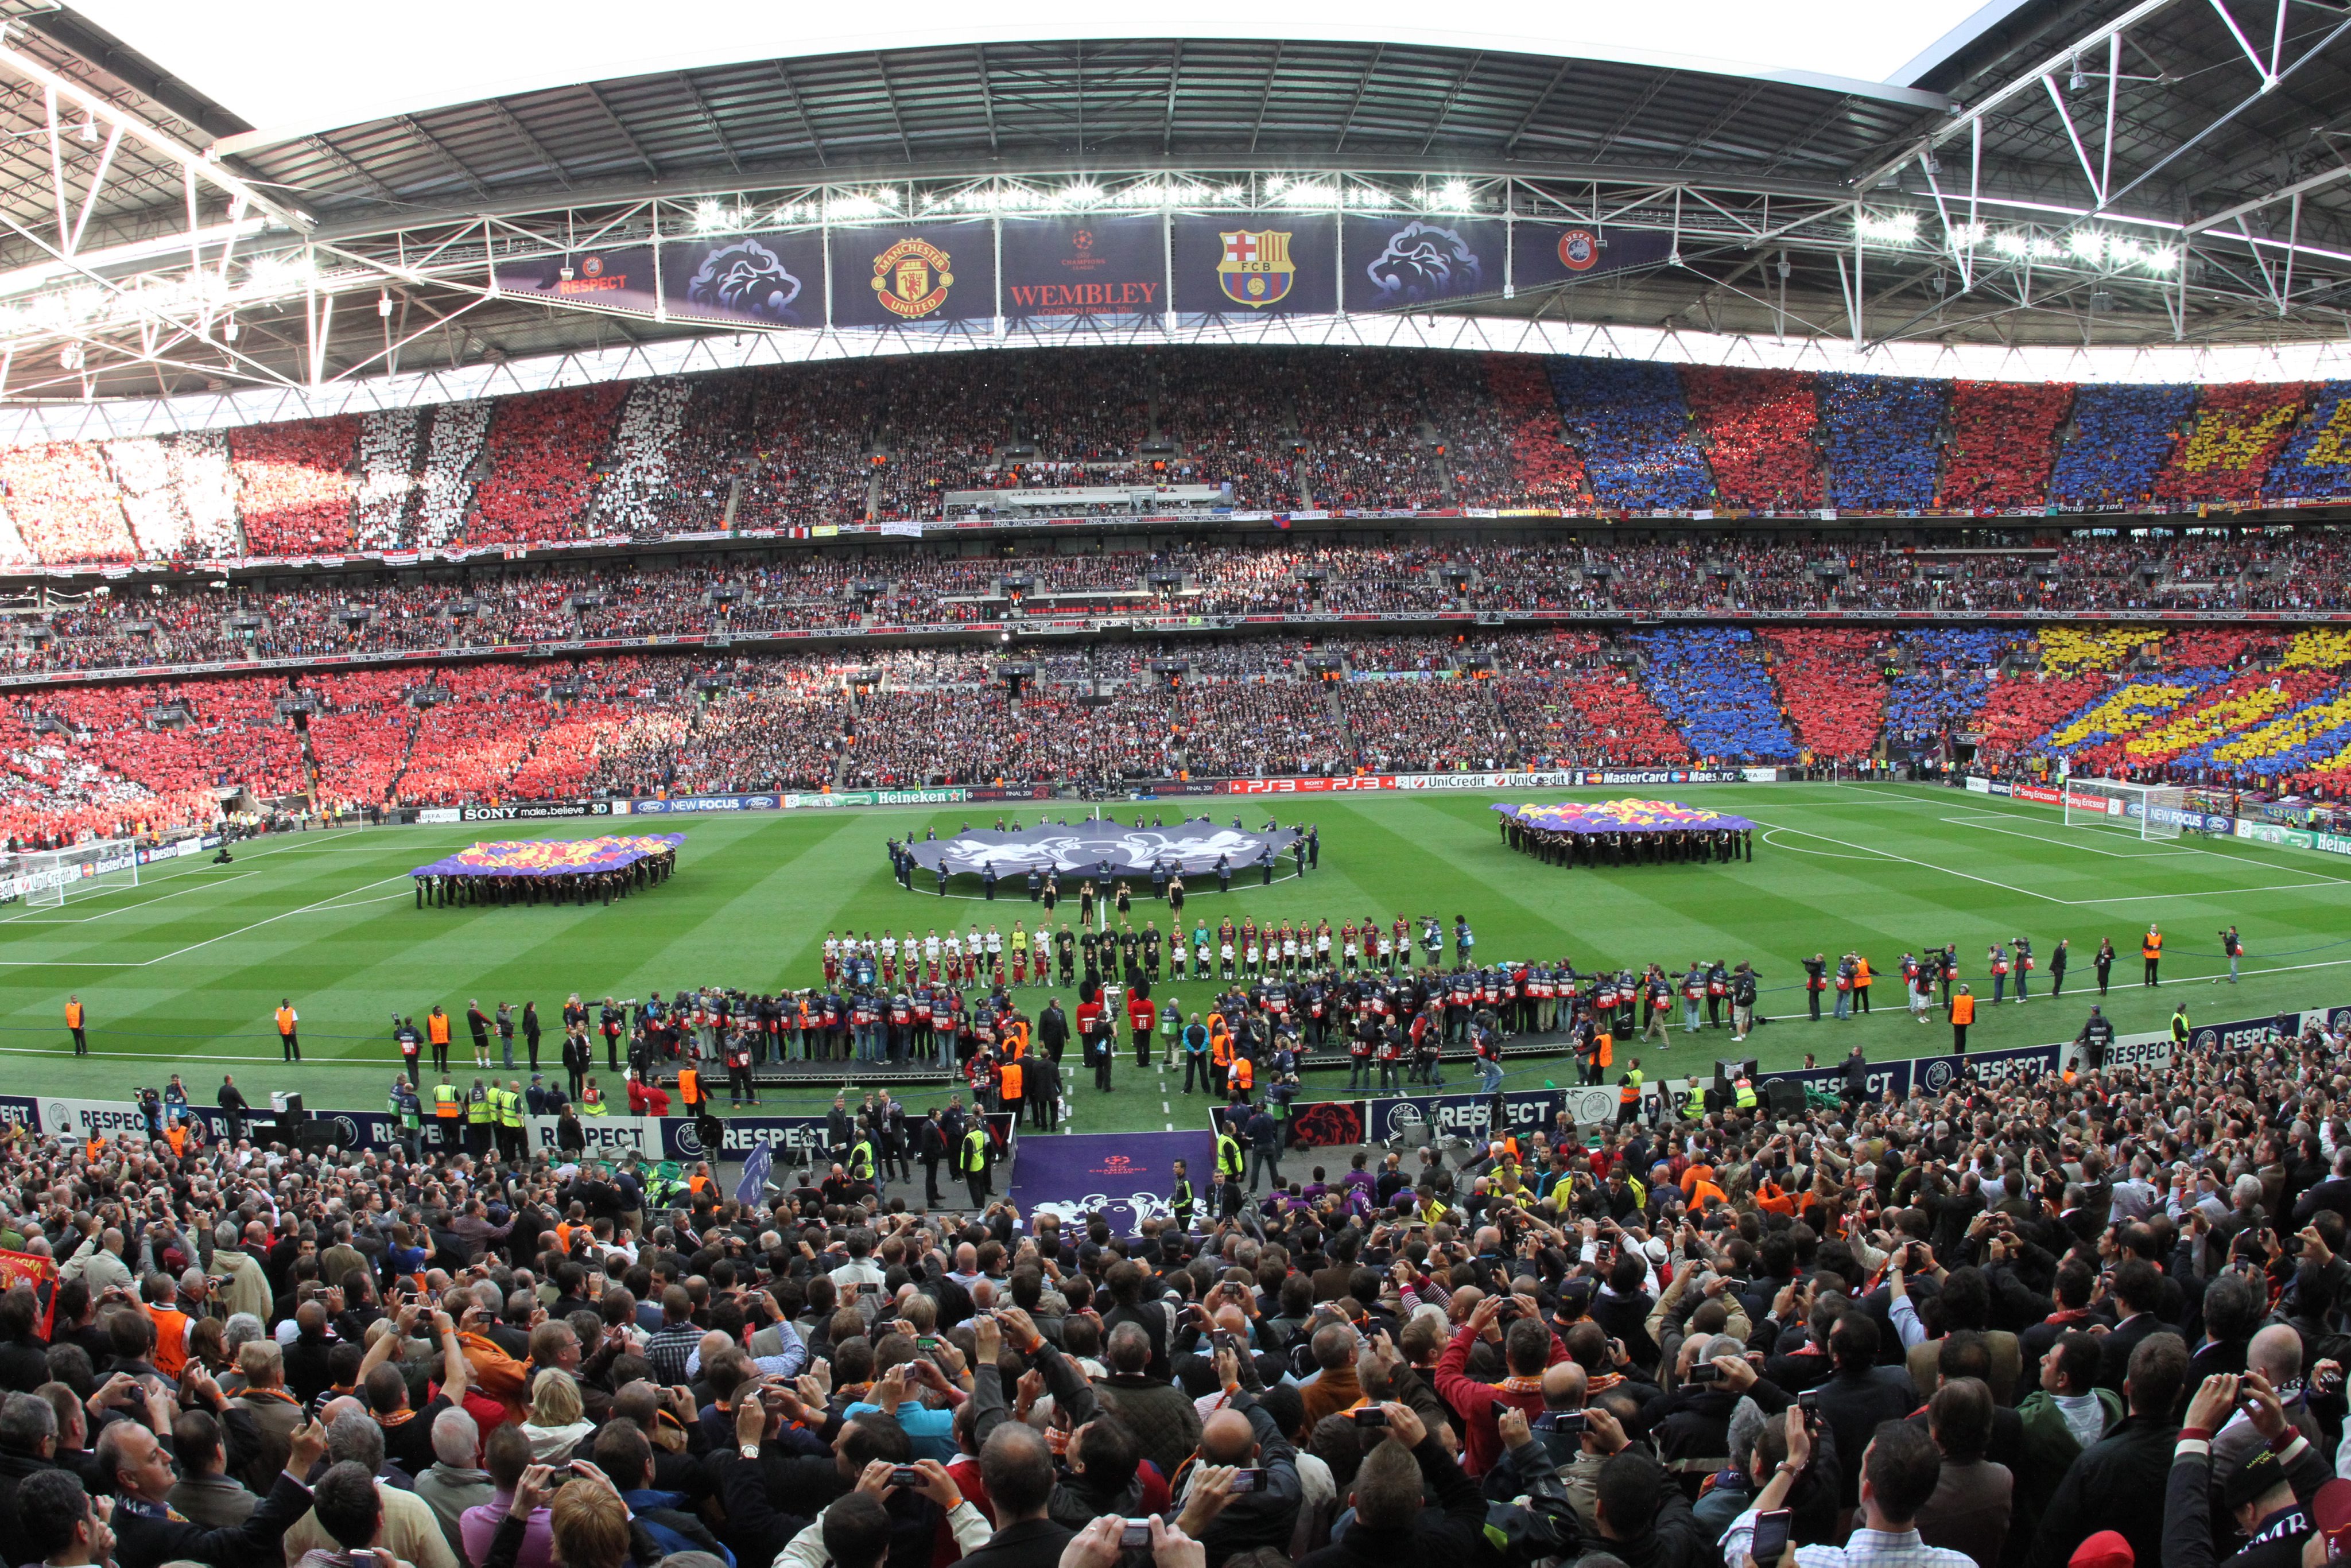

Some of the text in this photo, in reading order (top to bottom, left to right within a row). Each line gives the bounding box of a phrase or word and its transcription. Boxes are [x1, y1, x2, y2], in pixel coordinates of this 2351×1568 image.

[1565, 232, 1590, 243] UEFA
[879, 243, 945, 271] MANCHESTER
[560, 275, 627, 295] RESPECT
[1010, 282, 1158, 306] WEMBLEY
[891, 298, 937, 313] UNITED
[1037, 307, 1083, 316] LONDON
[1085, 306, 1112, 315] FINAL
[1332, 777, 1380, 790] PS3
[1429, 775, 1485, 787] UniCredit
[1603, 770, 1734, 784] MasterCard Maesro
[1247, 779, 1296, 793] PS3
[878, 791, 946, 804] Heineken
[2021, 788, 2057, 801] Sony Ericsson
[642, 802, 662, 811] Ford
[671, 798, 739, 810] NEW FOCUS
[751, 798, 770, 806] Ford
[465, 807, 518, 820] SONY
[591, 804, 607, 814] 3D
[2151, 809, 2202, 827] NEW FOCUS
[2210, 818, 2225, 829] Ford
[149, 845, 177, 861] Maestro
[32, 870, 72, 891] UniCredit
[1931, 1062, 1947, 1071] UEFA
[1587, 1094, 1606, 1102] UEFA
[80, 1109, 145, 1131] RESPEC
[1393, 1101, 1550, 1127] UEFA RESECT
[540, 1127, 643, 1148] RPECT
[722, 1128, 829, 1150] RESPECT
